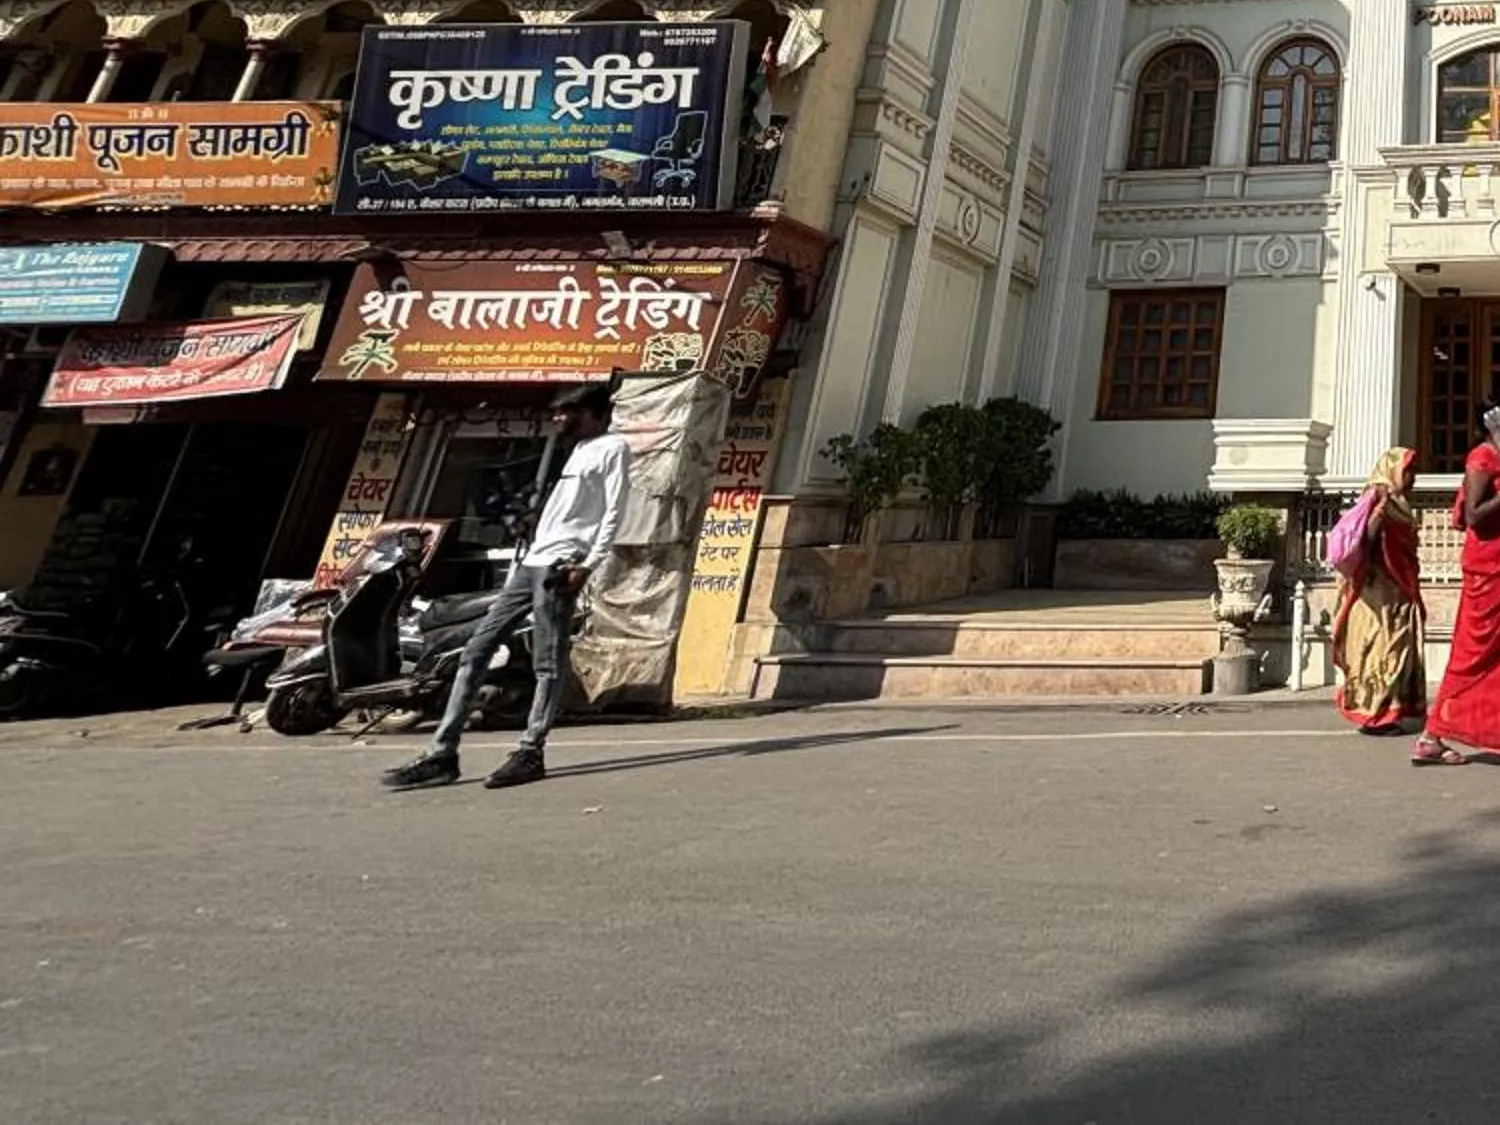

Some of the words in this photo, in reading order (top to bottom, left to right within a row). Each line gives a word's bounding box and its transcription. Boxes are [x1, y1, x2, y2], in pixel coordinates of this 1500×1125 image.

[1415, 5, 1496, 26] POONAM
[388, 68, 543, 130] कृष्णा
[550, 50, 700, 121] ट्रेडिंग
[88, 123, 179, 172] पूजन
[190, 112, 312, 159] सामग्री
[358, 277, 424, 330] श्री
[427, 276, 593, 331] बालाजी
[593, 276, 713, 340] ट्रेडिंग
[717, 442, 769, 477] चेयर
[347, 472, 395, 502] चेयर
